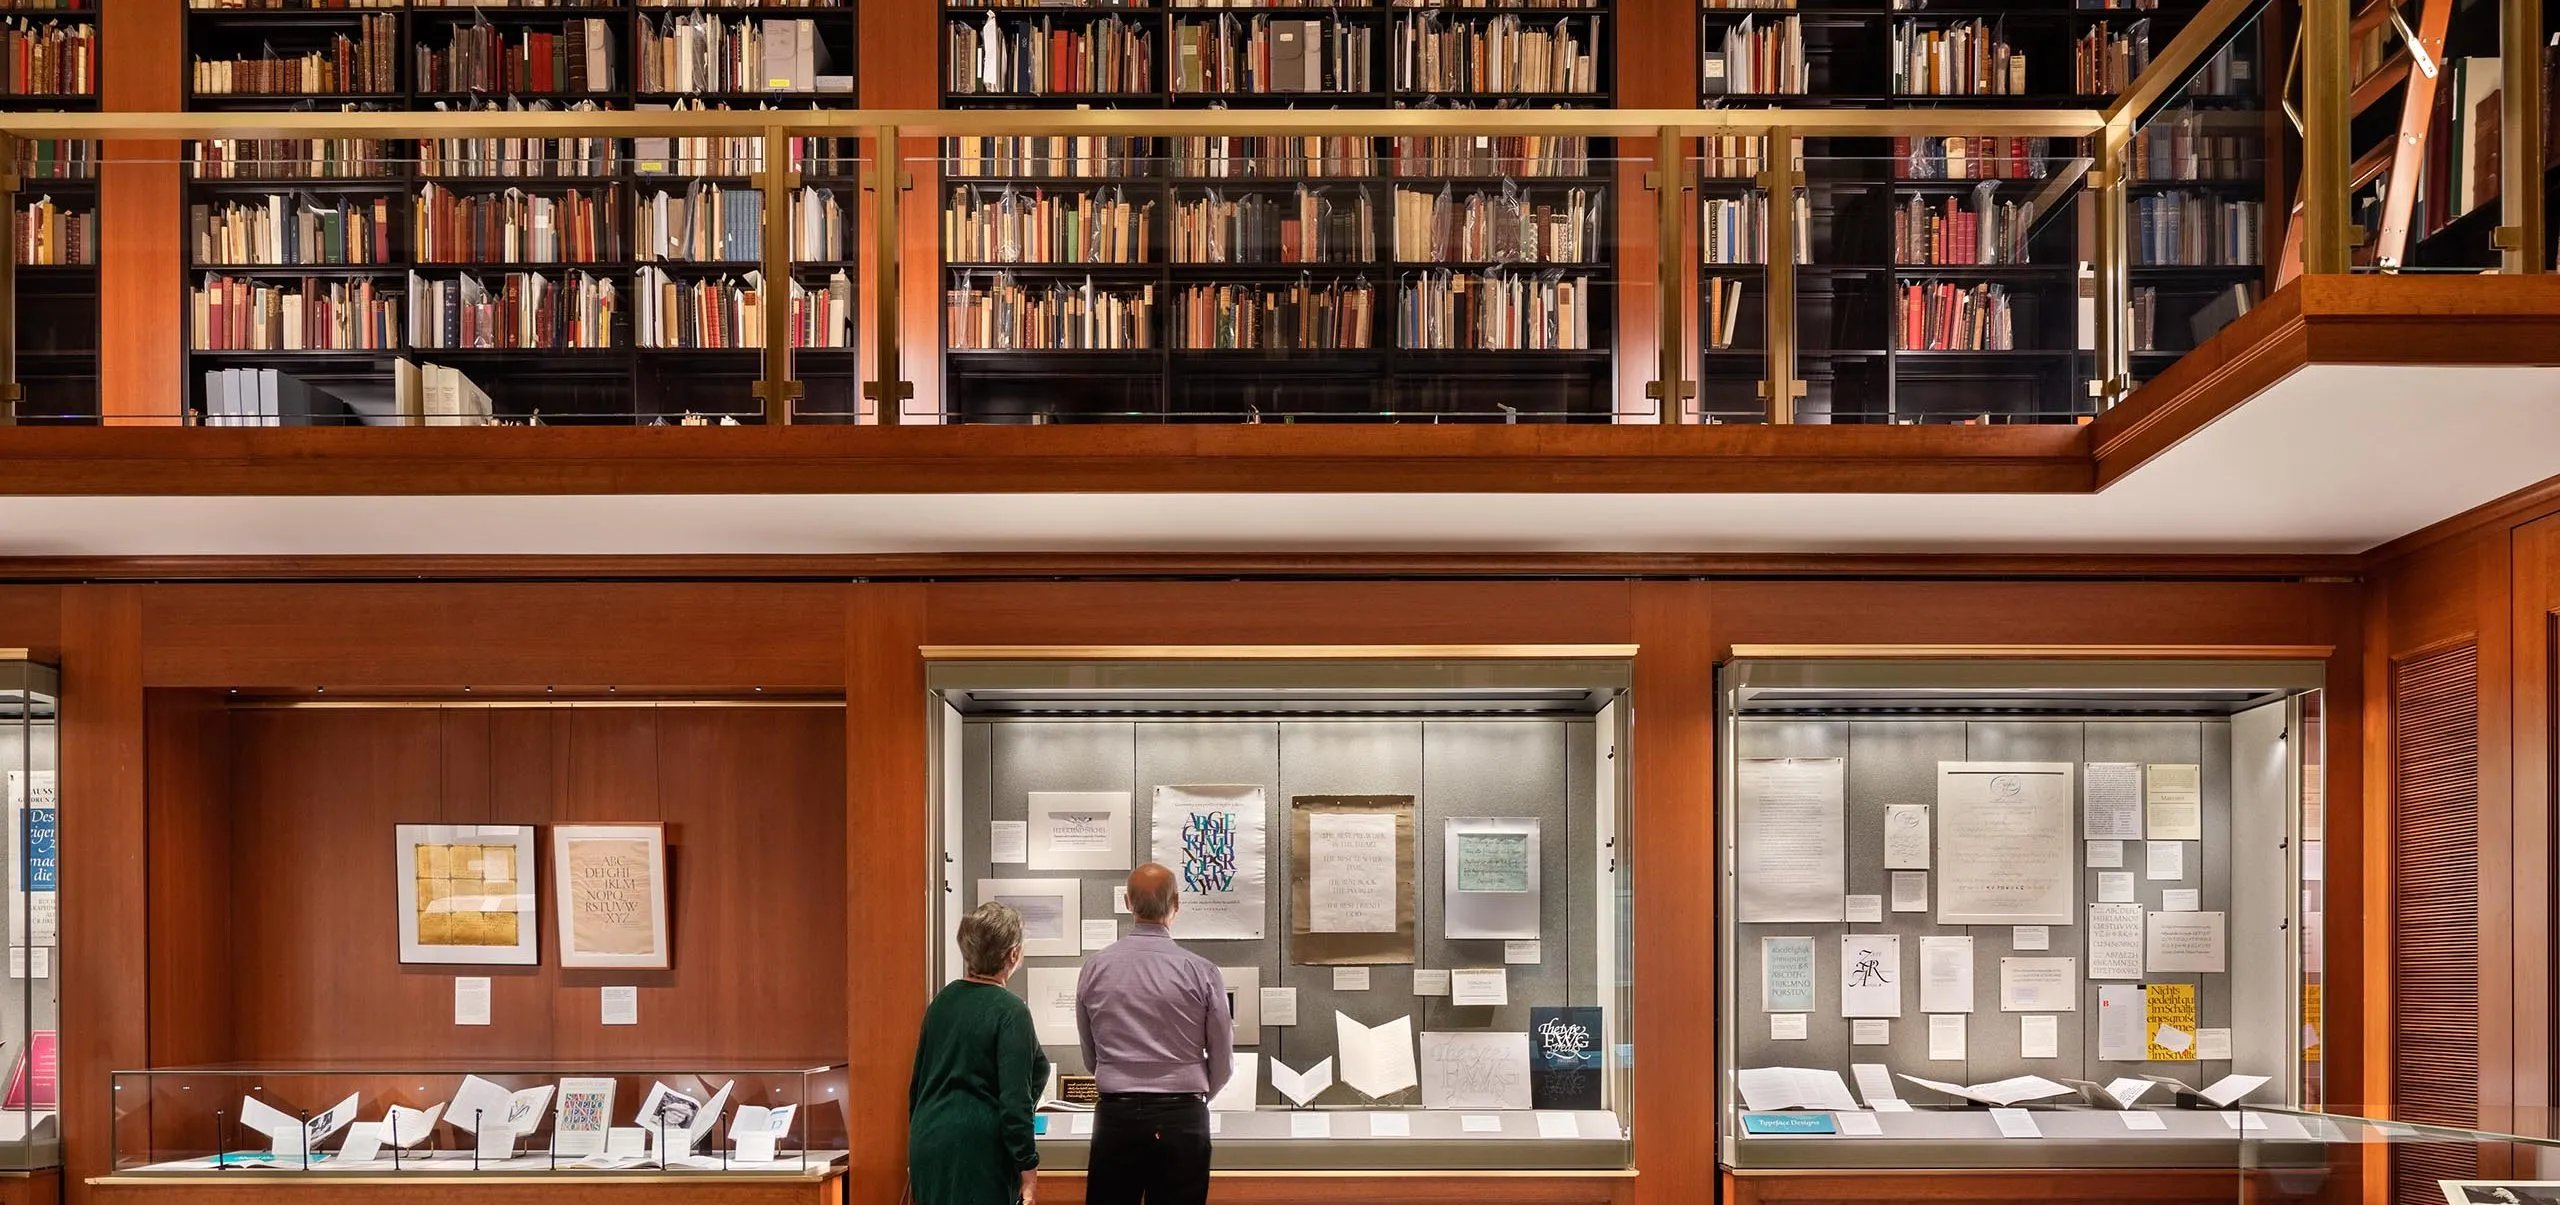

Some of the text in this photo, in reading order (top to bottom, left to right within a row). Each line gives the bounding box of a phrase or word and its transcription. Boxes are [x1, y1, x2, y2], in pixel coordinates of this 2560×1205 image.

[30, 809, 55, 823] Des
[33, 867, 53, 881] die
[2151, 985, 2180, 995] Nichts
[1540, 1032, 1590, 1048] EWG
[1760, 1119, 1820, 1128] Typeface Designs
